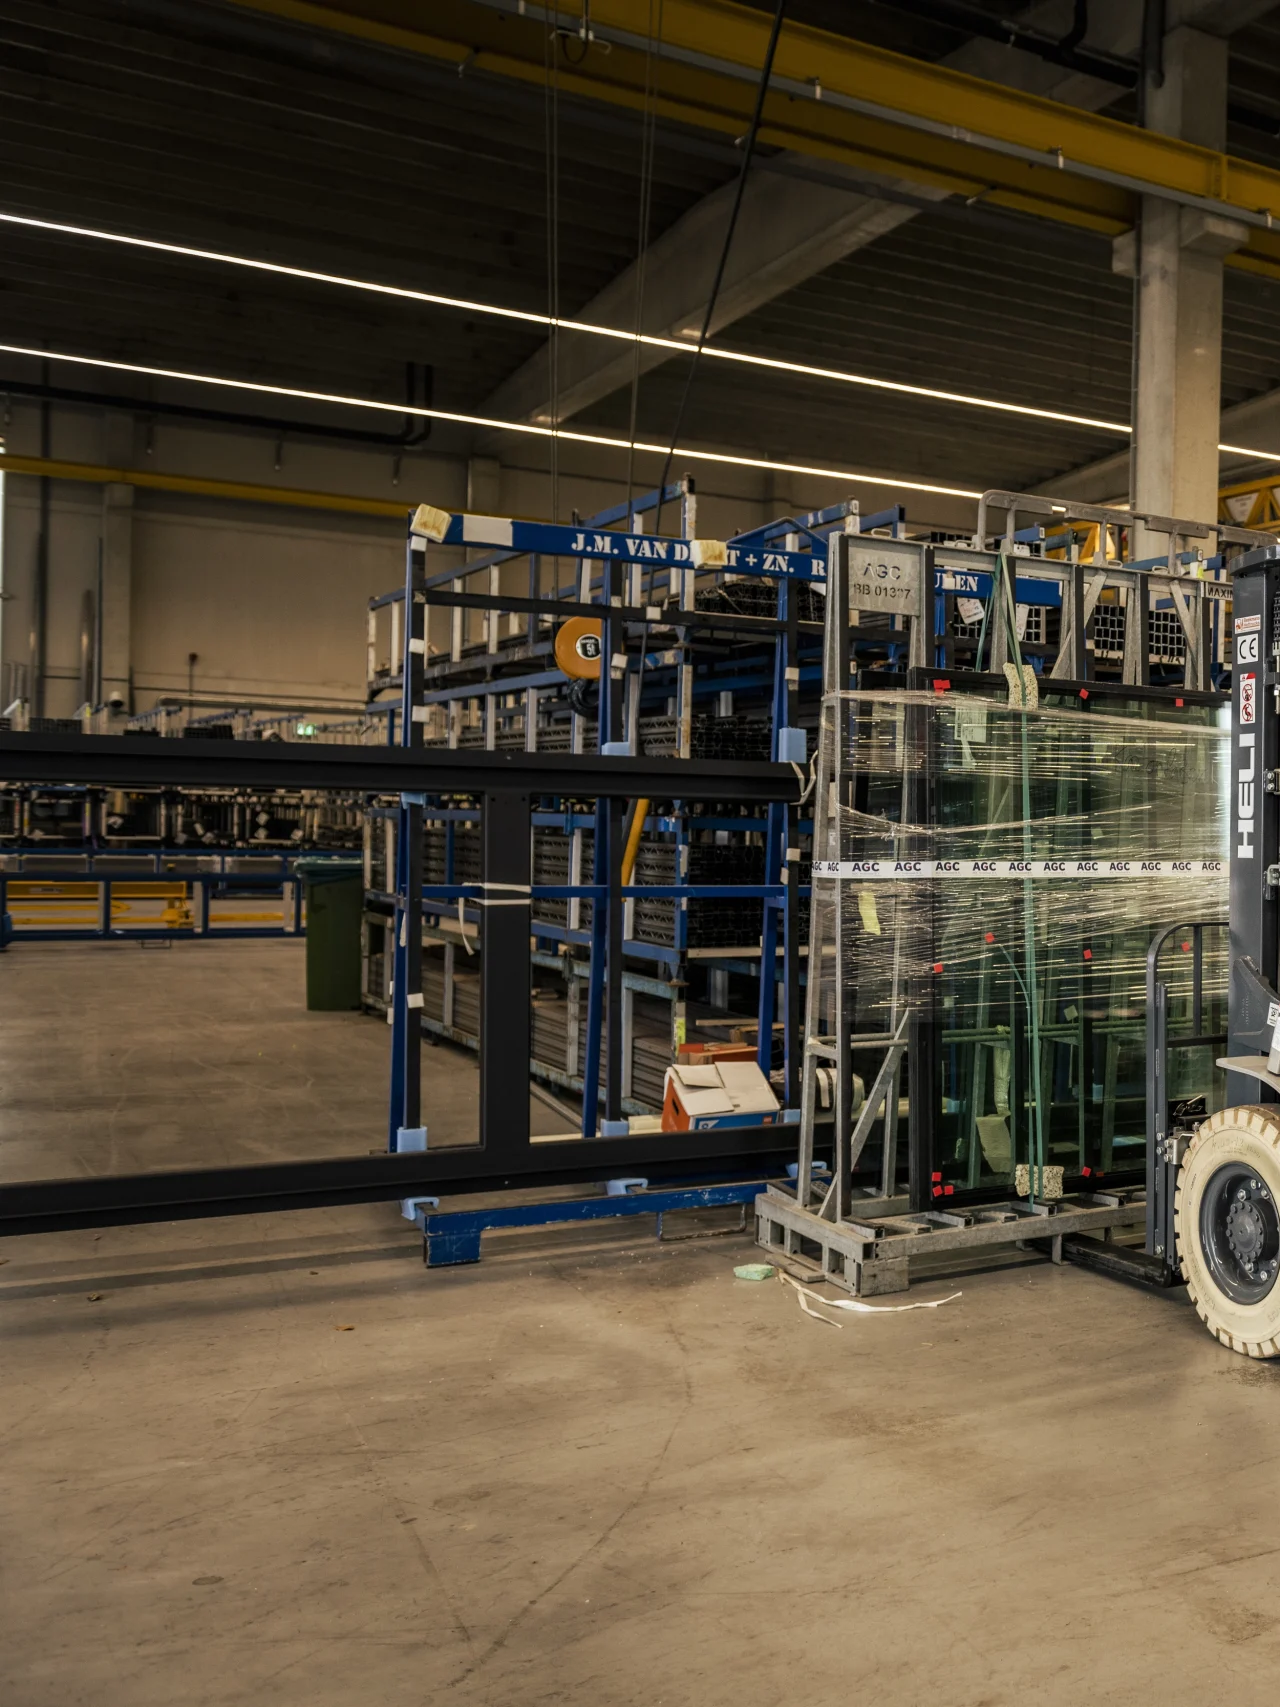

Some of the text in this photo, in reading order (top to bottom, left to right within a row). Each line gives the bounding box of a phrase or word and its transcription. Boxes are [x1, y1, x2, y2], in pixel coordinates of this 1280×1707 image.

[571, 533, 619, 555] J.M.
[625, 538, 668, 560] VAN
[745, 554, 758, 566] +
[762, 553, 795, 573] ZN.
[863, 563, 901, 580] AGC
[1239, 637, 1257, 660] CE
[1237, 733, 1256, 859] HELI
[827, 862, 840, 872] AGC
[852, 862, 880, 872] AGC
[894, 862, 922, 872] AGC
[935, 862, 960, 872] AGC
[972, 861, 997, 872] AGC
[1008, 862, 1032, 871] AGC
[1043, 862, 1066, 871] AGC
[1076, 862, 1098, 871] AGC
[1109, 862, 1130, 871] AGC
[1140, 862, 1162, 871] AGC
[1172, 862, 1192, 871] AGC
[1201, 862, 1221, 871] AGC
